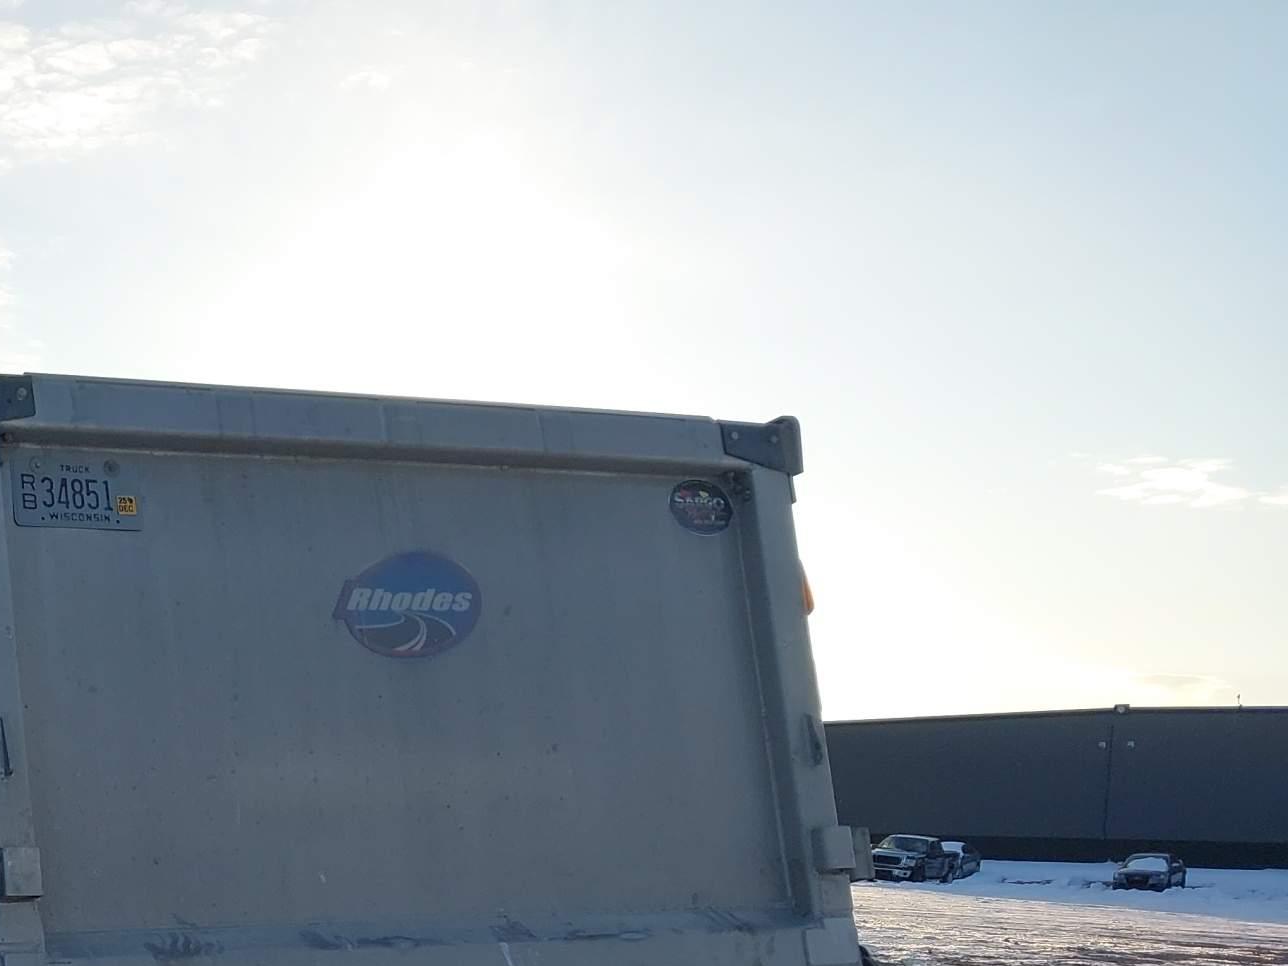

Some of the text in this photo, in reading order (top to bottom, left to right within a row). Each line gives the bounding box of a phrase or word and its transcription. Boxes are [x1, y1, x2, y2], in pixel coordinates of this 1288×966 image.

[59, 464, 91, 474] TRUCK
[40, 476, 114, 512] 34851
[48, 512, 111, 523] WISCONSIN
[346, 587, 473, 612] Rhodes
